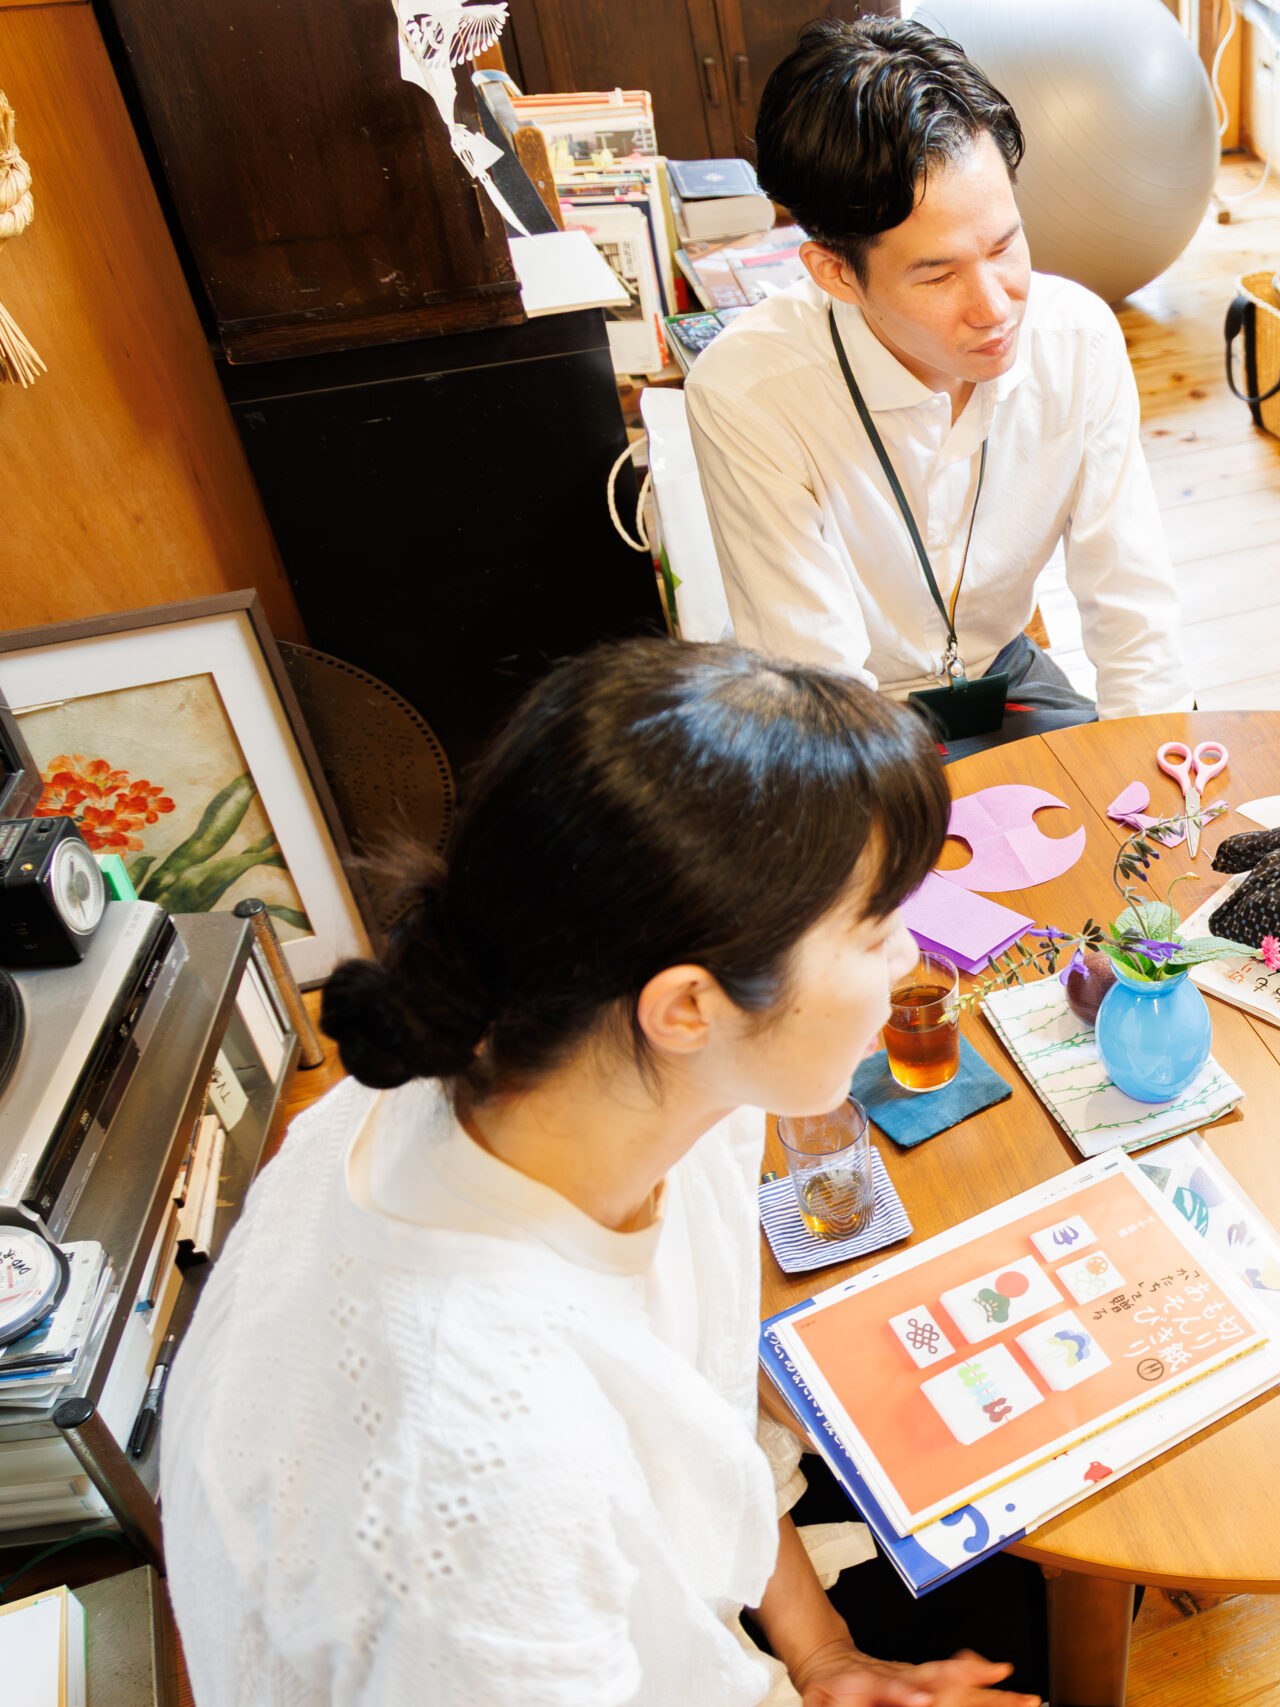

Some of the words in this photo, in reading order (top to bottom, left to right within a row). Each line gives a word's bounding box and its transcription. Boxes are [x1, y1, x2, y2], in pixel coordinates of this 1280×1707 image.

[1092, 1268, 1200, 1320] 「かたち」を贈る
[1134, 1282, 1210, 1326] あそび
[1122, 1301, 1226, 1357] もんきり
[1158, 1314, 1244, 1372] 切り紙
